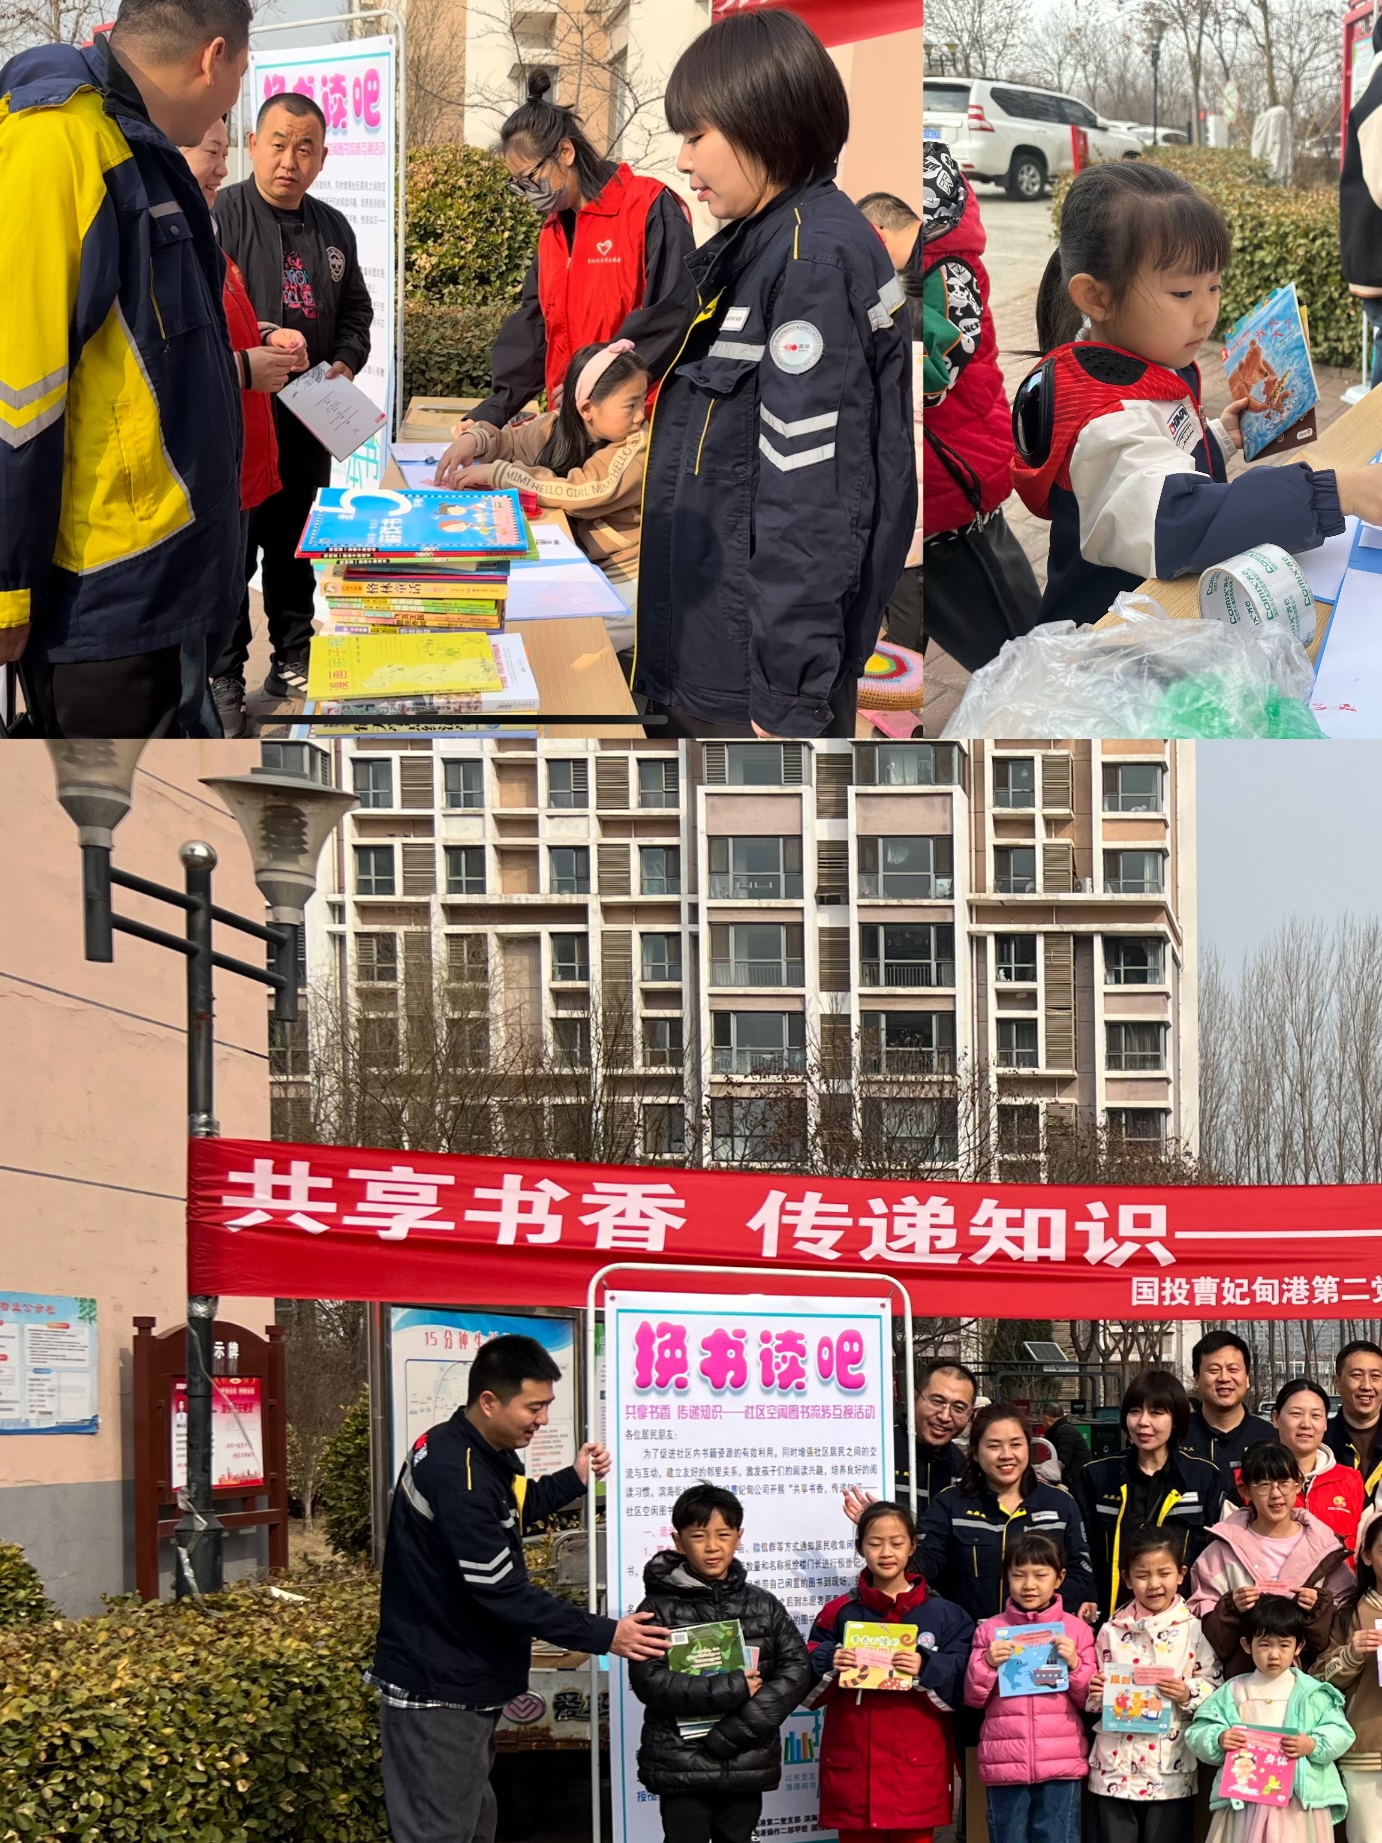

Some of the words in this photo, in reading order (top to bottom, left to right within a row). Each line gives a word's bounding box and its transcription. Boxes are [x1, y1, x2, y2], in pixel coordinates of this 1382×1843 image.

[532, 482, 563, 496] HELLO
[566, 486, 590, 498] GIRL
[366, 583, 421, 595] 格林童话
[221, 1157, 686, 1253] 共享书香
[633, 1320, 867, 1391] 换书读吧
[624, 1405, 671, 1421] 共享书香
